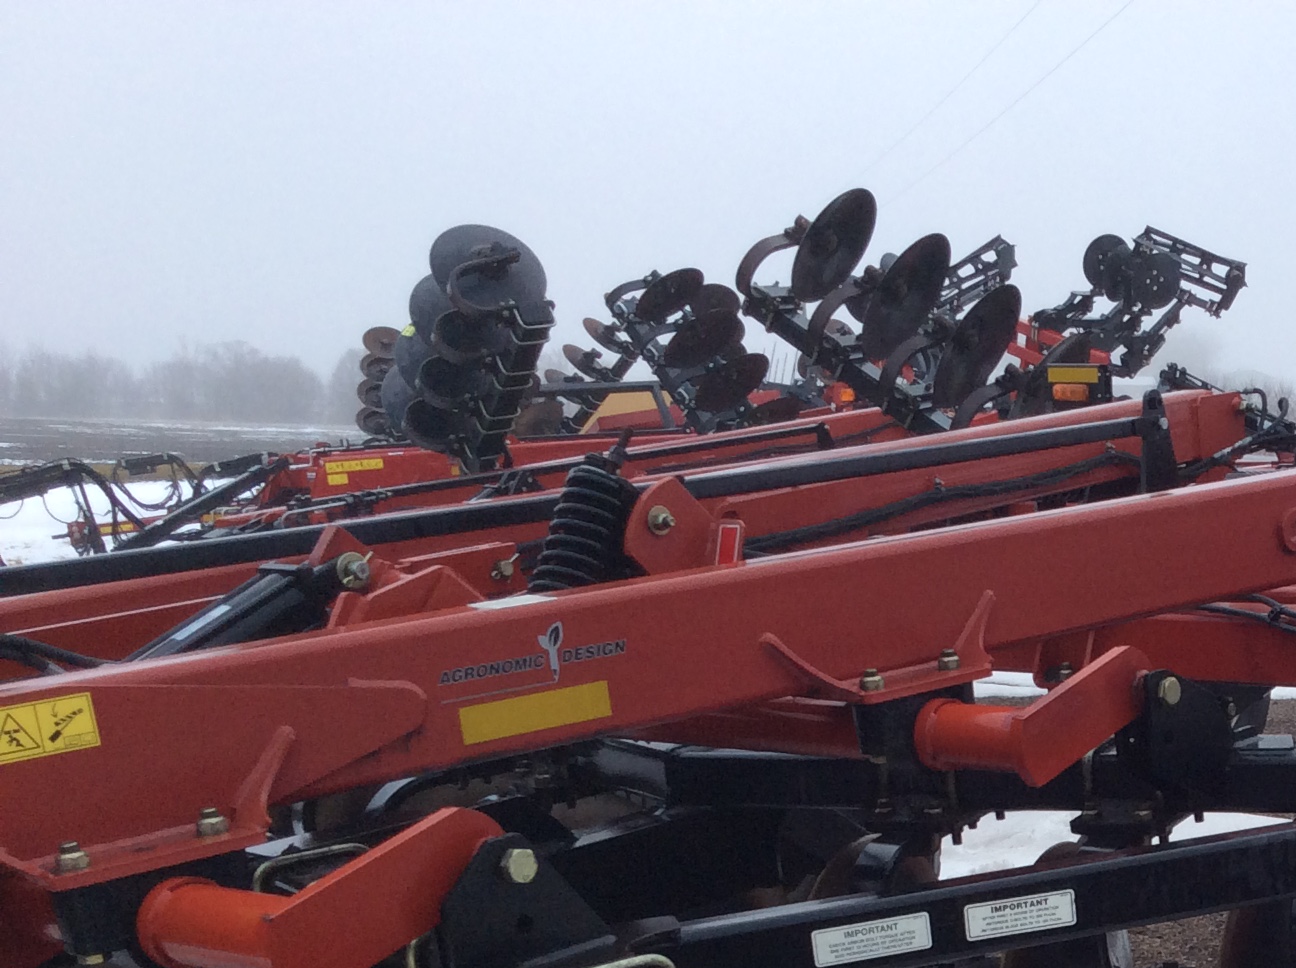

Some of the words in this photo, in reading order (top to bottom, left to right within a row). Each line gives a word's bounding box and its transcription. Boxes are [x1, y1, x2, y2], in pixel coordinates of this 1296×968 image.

[438, 654, 545, 686] AGRONOMIC
[561, 638, 627, 664] DESIGN
[990, 898, 1049, 914] IMPORTANT
[843, 922, 898, 939] IMPORTANT
